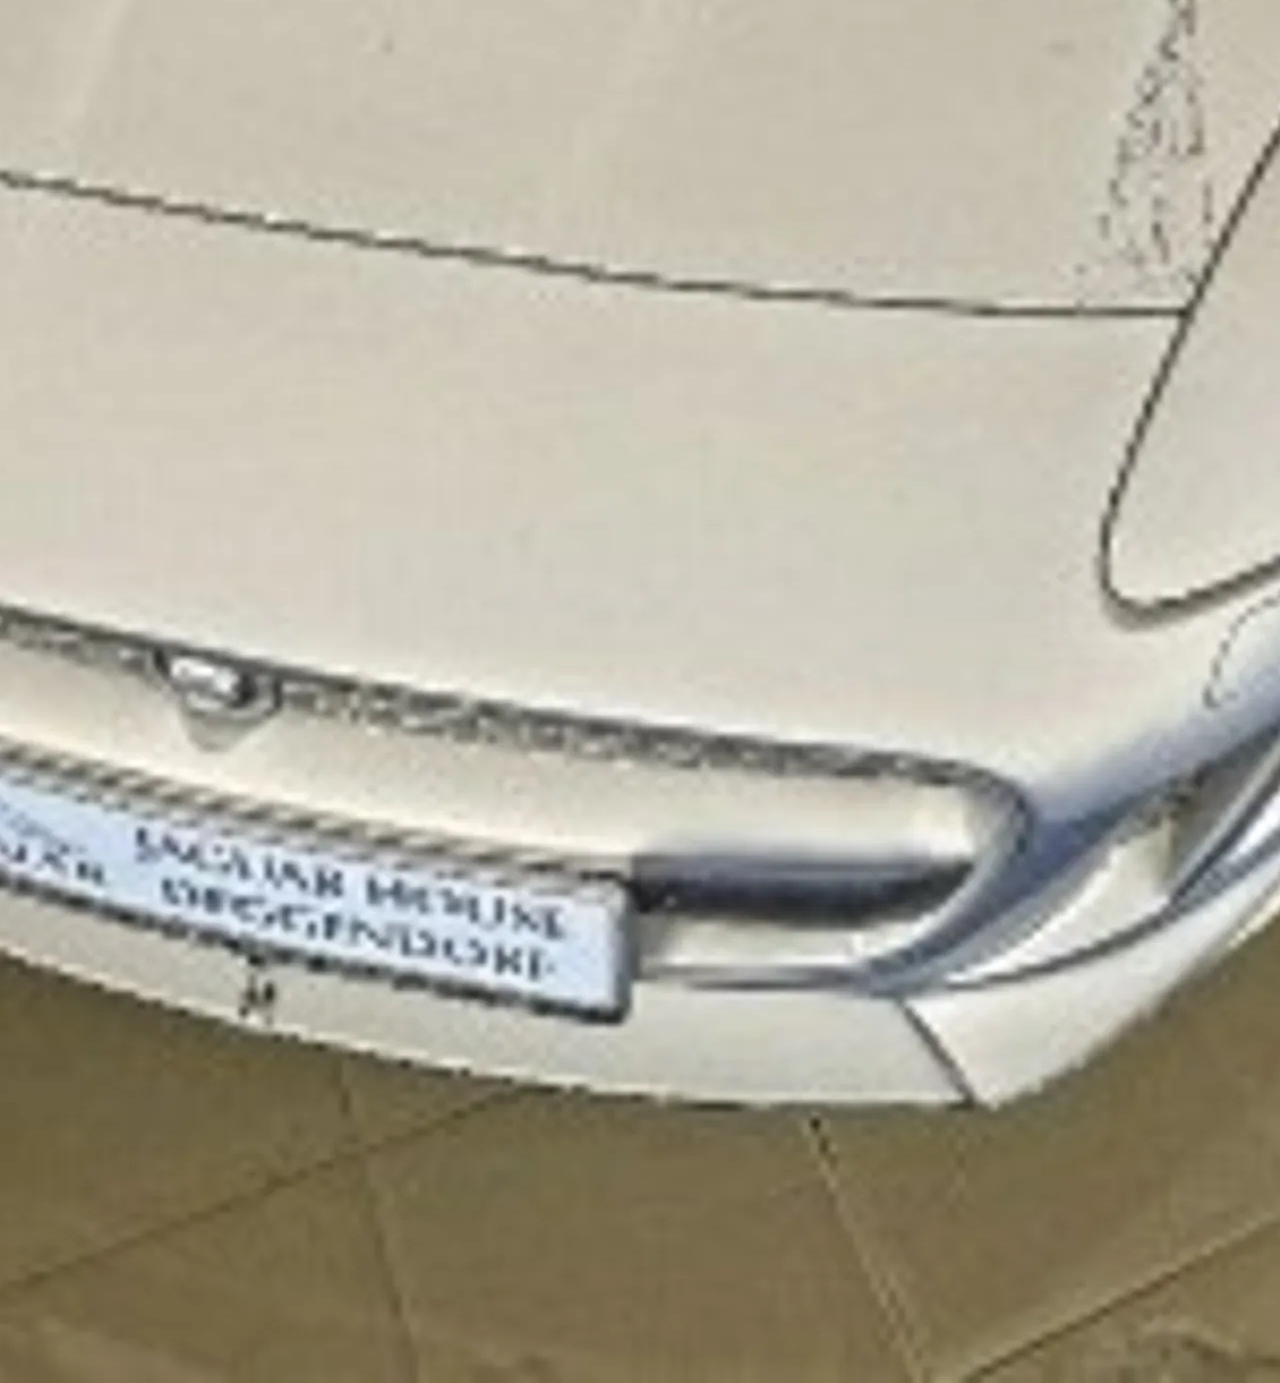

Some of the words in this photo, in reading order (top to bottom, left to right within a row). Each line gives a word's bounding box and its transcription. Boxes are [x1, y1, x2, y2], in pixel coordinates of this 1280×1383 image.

[135, 825, 344, 899] JAGUAR
[365, 874, 566, 939] HOUSE
[161, 877, 555, 982] DEGGENDORF
